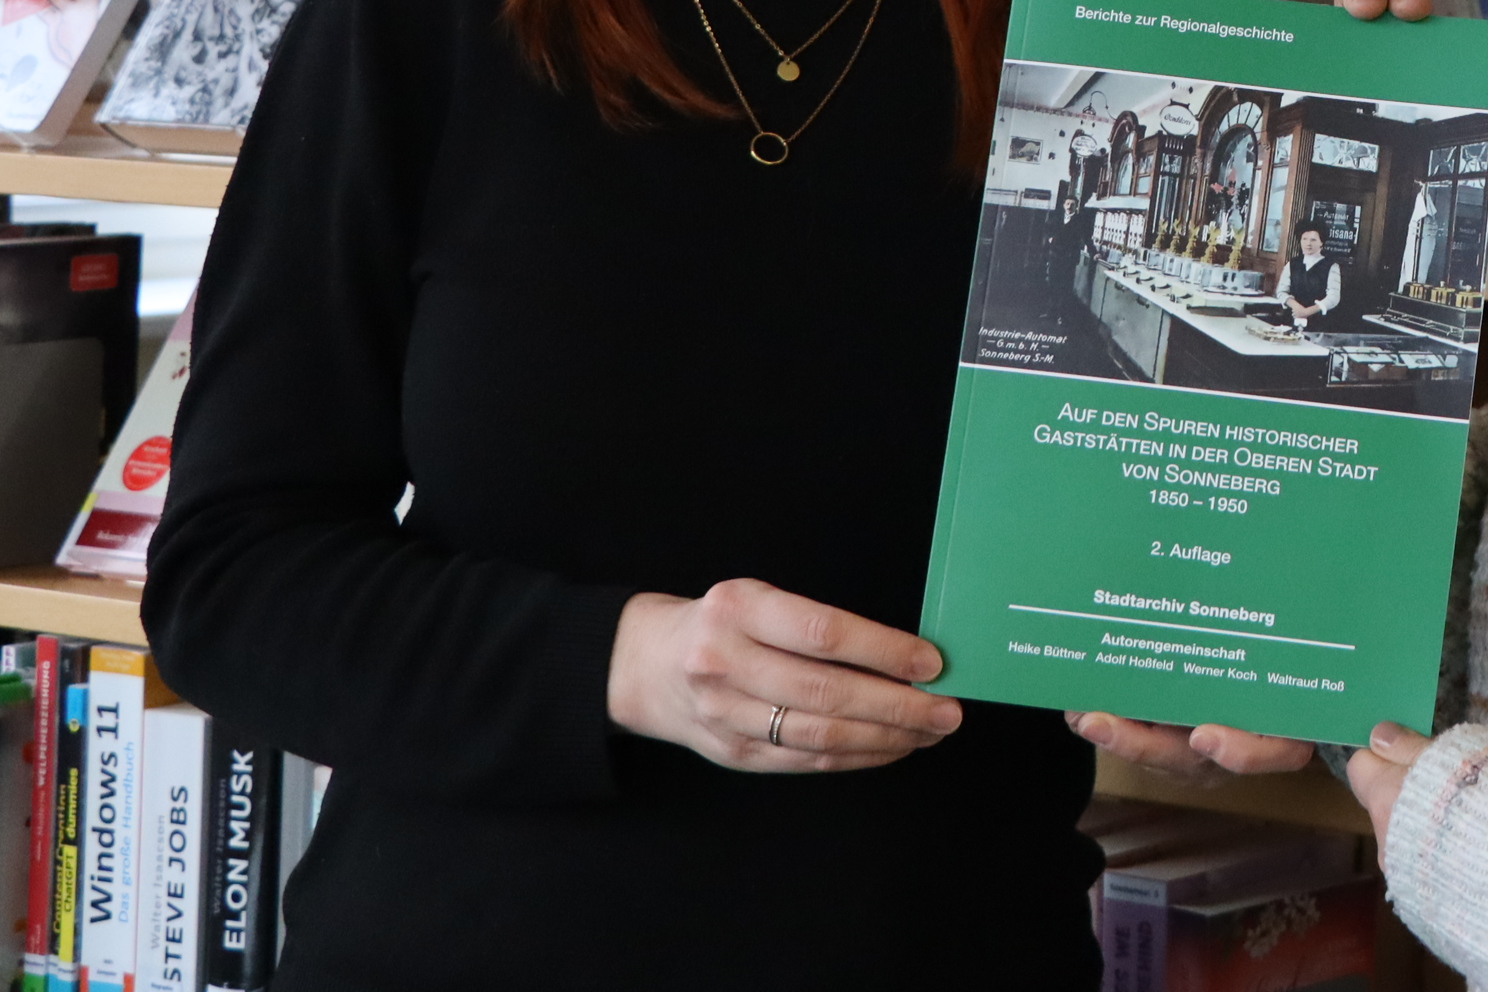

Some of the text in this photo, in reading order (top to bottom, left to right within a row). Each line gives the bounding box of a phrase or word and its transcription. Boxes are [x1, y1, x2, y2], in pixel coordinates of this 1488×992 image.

[1075, 5, 1295, 43] Berichte zur Regionalgeschichte
[978, 326, 1068, 345] Industrie-Automat
[979, 348, 1032, 364] Sonneberg
[1057, 402, 1359, 455] AUF DEN SPUREN HISTORISCHER
[1033, 424, 1379, 482] GASTSTÄTTEN IN DER OBEREN STADT
[1121, 462, 1282, 496] VON SONNEBERG
[1148, 488, 1190, 508] 1850
[1208, 495, 1249, 515] 1950
[1150, 540, 1232, 567] 2. Auflage
[1093, 589, 1276, 628] Stadtarchiv Sonneberg
[1008, 640, 1346, 693] Heike Büttner Adolf Hoßfeld Werner Koch Waltraud Roß
[1100, 632, 1247, 663] Autorengemeinschaft
[96, 701, 120, 741] 11
[63, 767, 80, 913] ChatGPT dummies
[89, 751, 118, 925] Windows
[118, 741, 136, 923] Das große Handbuch
[223, 749, 254, 951] ELON MUSK
[150, 814, 165, 951] Walter Isaacson
[164, 785, 189, 983] STEVE JOBS
